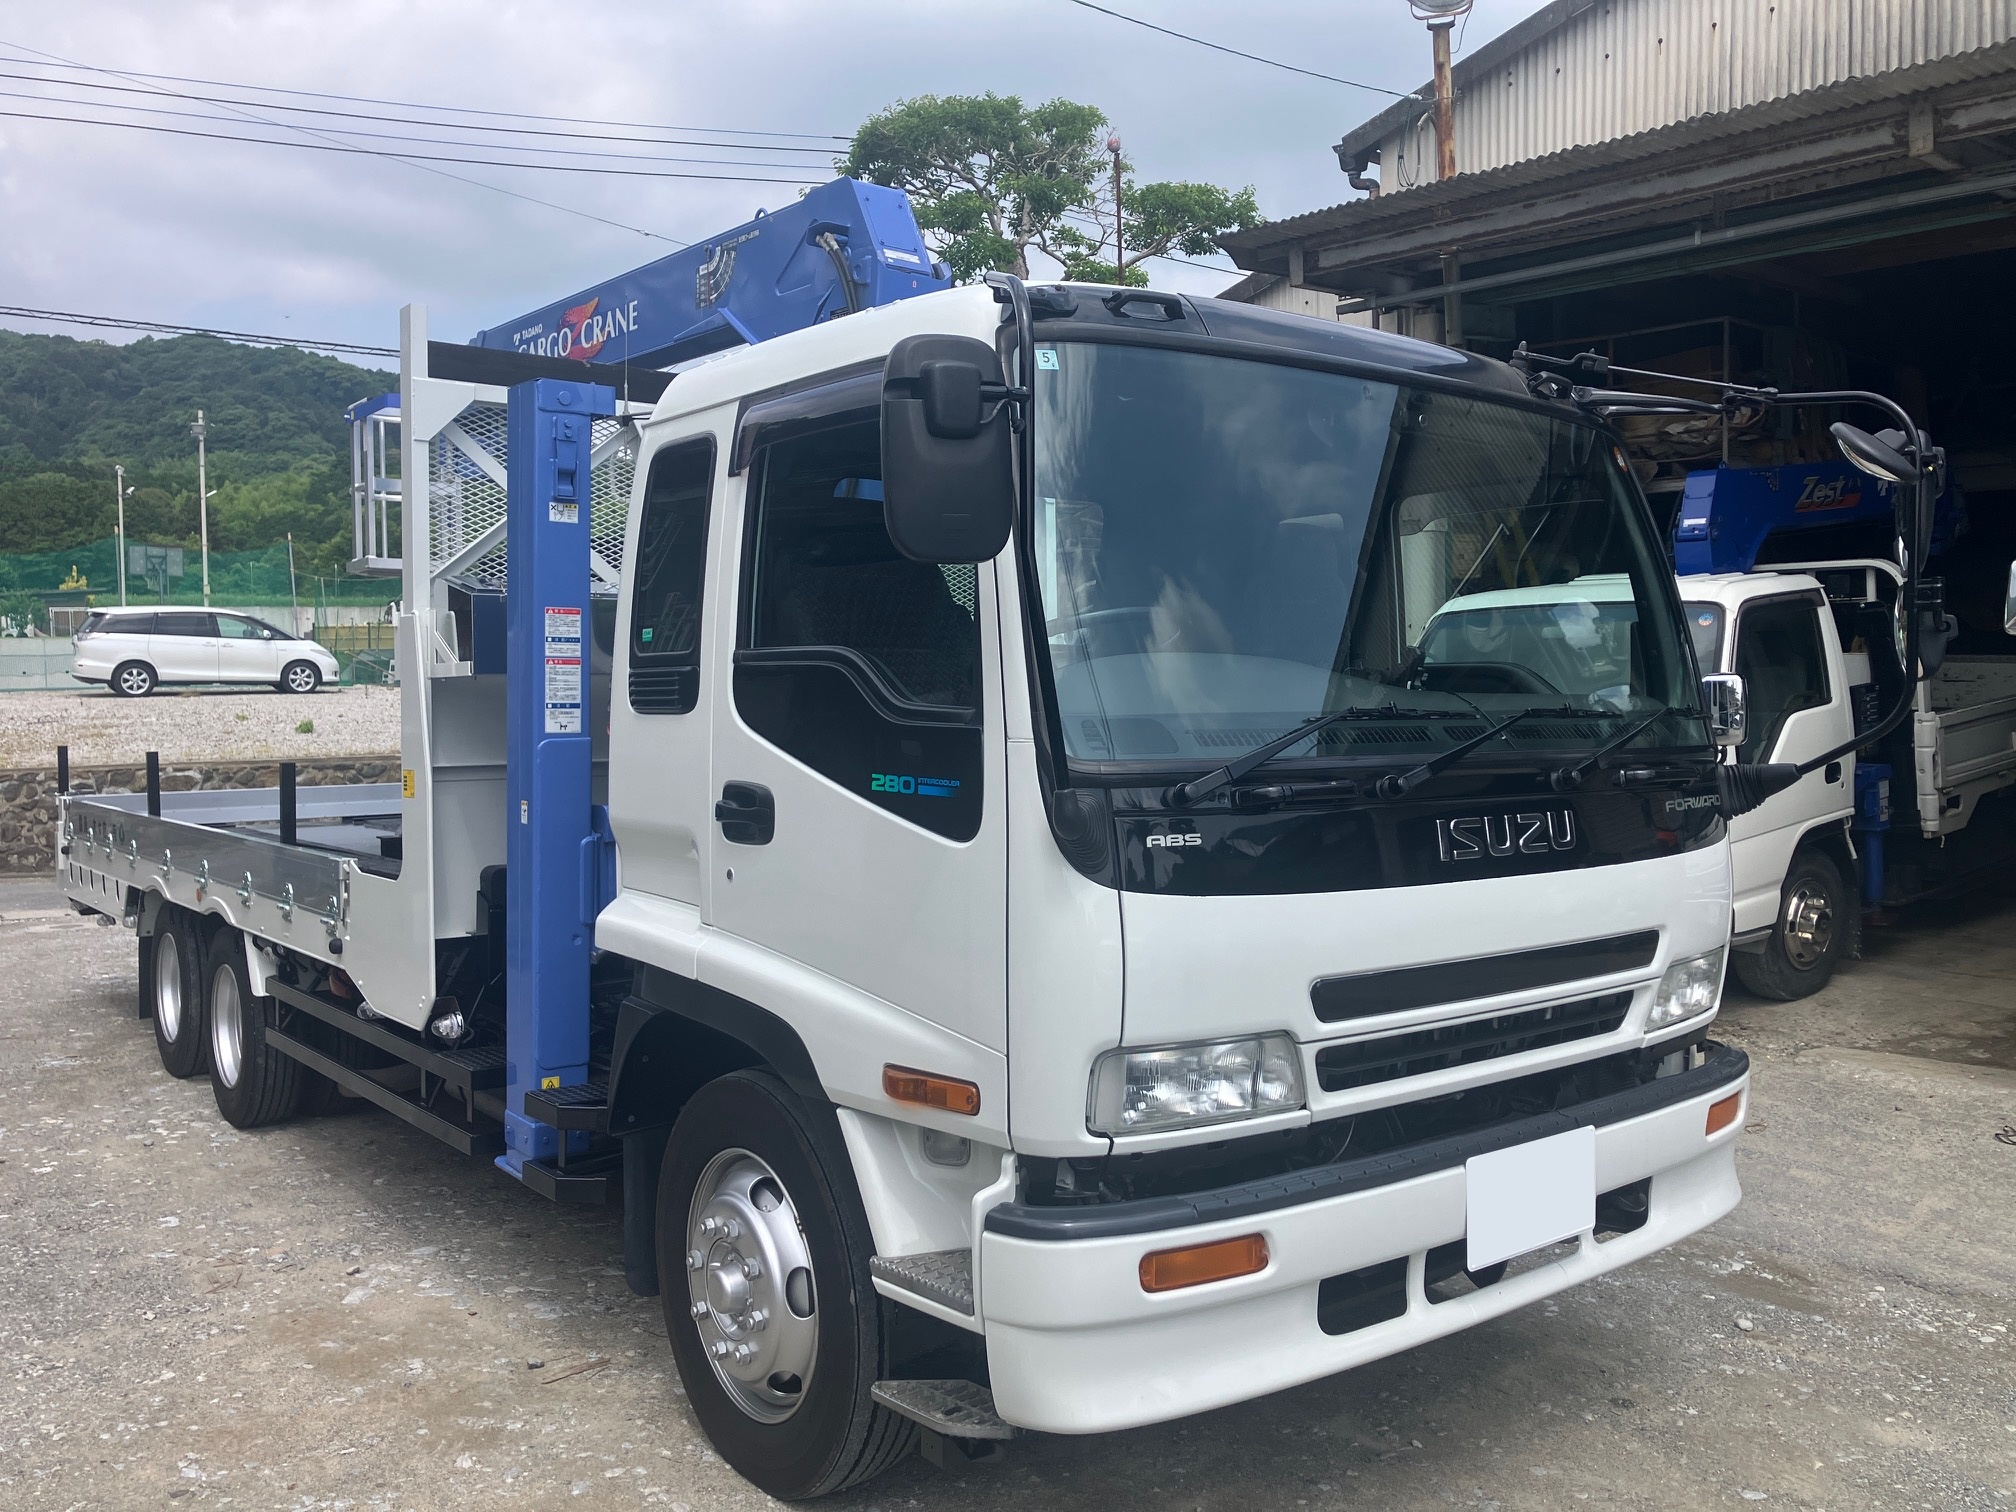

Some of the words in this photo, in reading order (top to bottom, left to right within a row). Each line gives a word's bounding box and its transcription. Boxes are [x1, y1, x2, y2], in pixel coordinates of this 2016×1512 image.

[522, 323, 543, 340] TADANO
[581, 300, 638, 348] CRANE
[1042, 352, 1050, 363] 5
[1795, 475, 1847, 509] Zest
[871, 773, 915, 794] 280
[917, 777, 960, 787] INTERCOOLER
[1665, 794, 1721, 813] FORWARD
[1146, 833, 1203, 848] ABS
[1436, 809, 1577, 862] ISUZU
